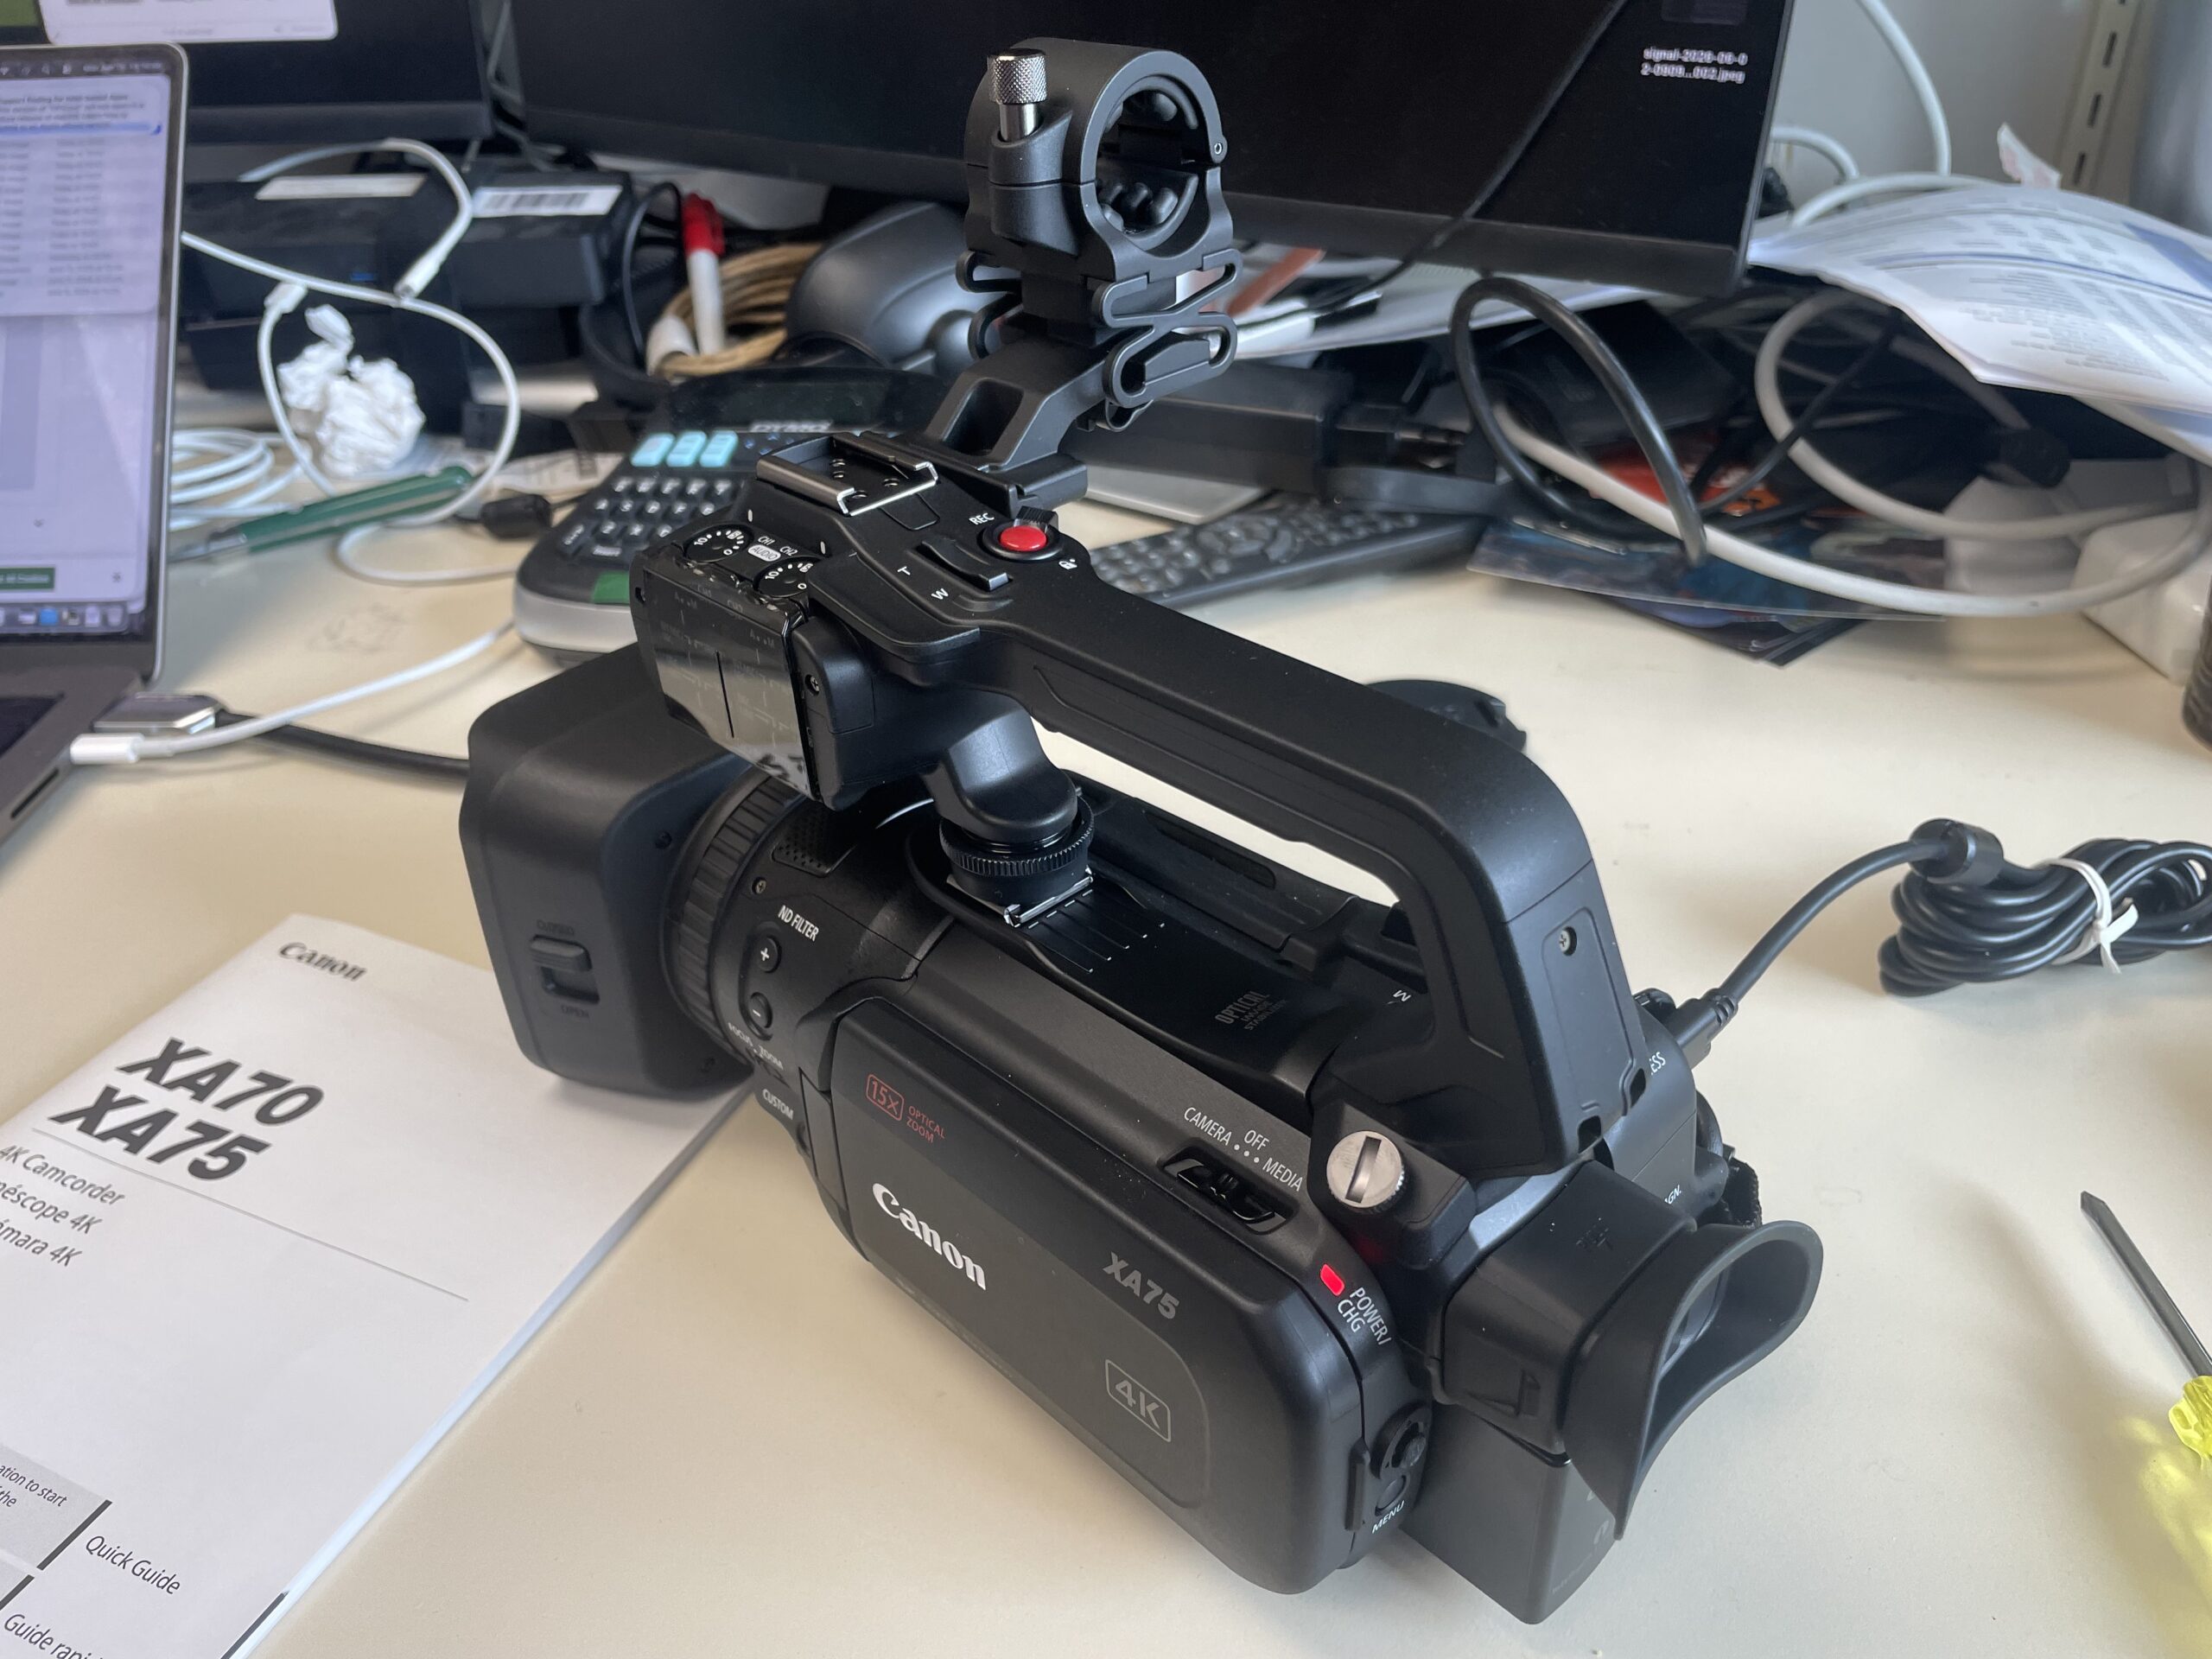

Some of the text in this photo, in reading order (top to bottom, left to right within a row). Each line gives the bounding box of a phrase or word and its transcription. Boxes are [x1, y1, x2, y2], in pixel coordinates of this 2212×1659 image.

[969, 512, 995, 525] REC
[693, 537, 709, 546] 10
[751, 545, 779, 561] AUDIO
[757, 535, 776, 546] CH1
[779, 545, 798, 556] CH2
[765, 570, 779, 580] 10
[897, 566, 912, 576] T
[931, 588, 950, 601] W
[778, 905, 820, 942] ND FILTER
[278, 941, 367, 982] Canon
[1214, 991, 1271, 1025] OPTICAL
[1649, 1052, 1667, 1076] ESS
[116, 1037, 325, 1126] XA70
[762, 1089, 794, 1121] CUSTOM
[47, 1084, 272, 1180] XA75
[906, 1116, 935, 1144] ZOOM
[908, 1105, 946, 1140] OPTICAL
[1183, 1107, 1304, 1192] CAMERA OFF MEDIA
[0, 1145, 126, 1205] 4K Camcorder
[69, 1214, 104, 1235] 4K
[872, 1182, 987, 1291] Canon
[49, 1245, 84, 1268] 4K
[1103, 1250, 1180, 1320] XA75
[1338, 1299, 1366, 1333] CHG
[1349, 1287, 1393, 1346] POWER/
[1115, 1379, 1160, 1430] 4K
[24, 1478, 40, 1493] to
[36, 1486, 68, 1508] start
[1371, 1500, 1406, 1535] MENU
[85, 1535, 181, 1596] Quick Guide
[3, 1613, 54, 1650] Guide
